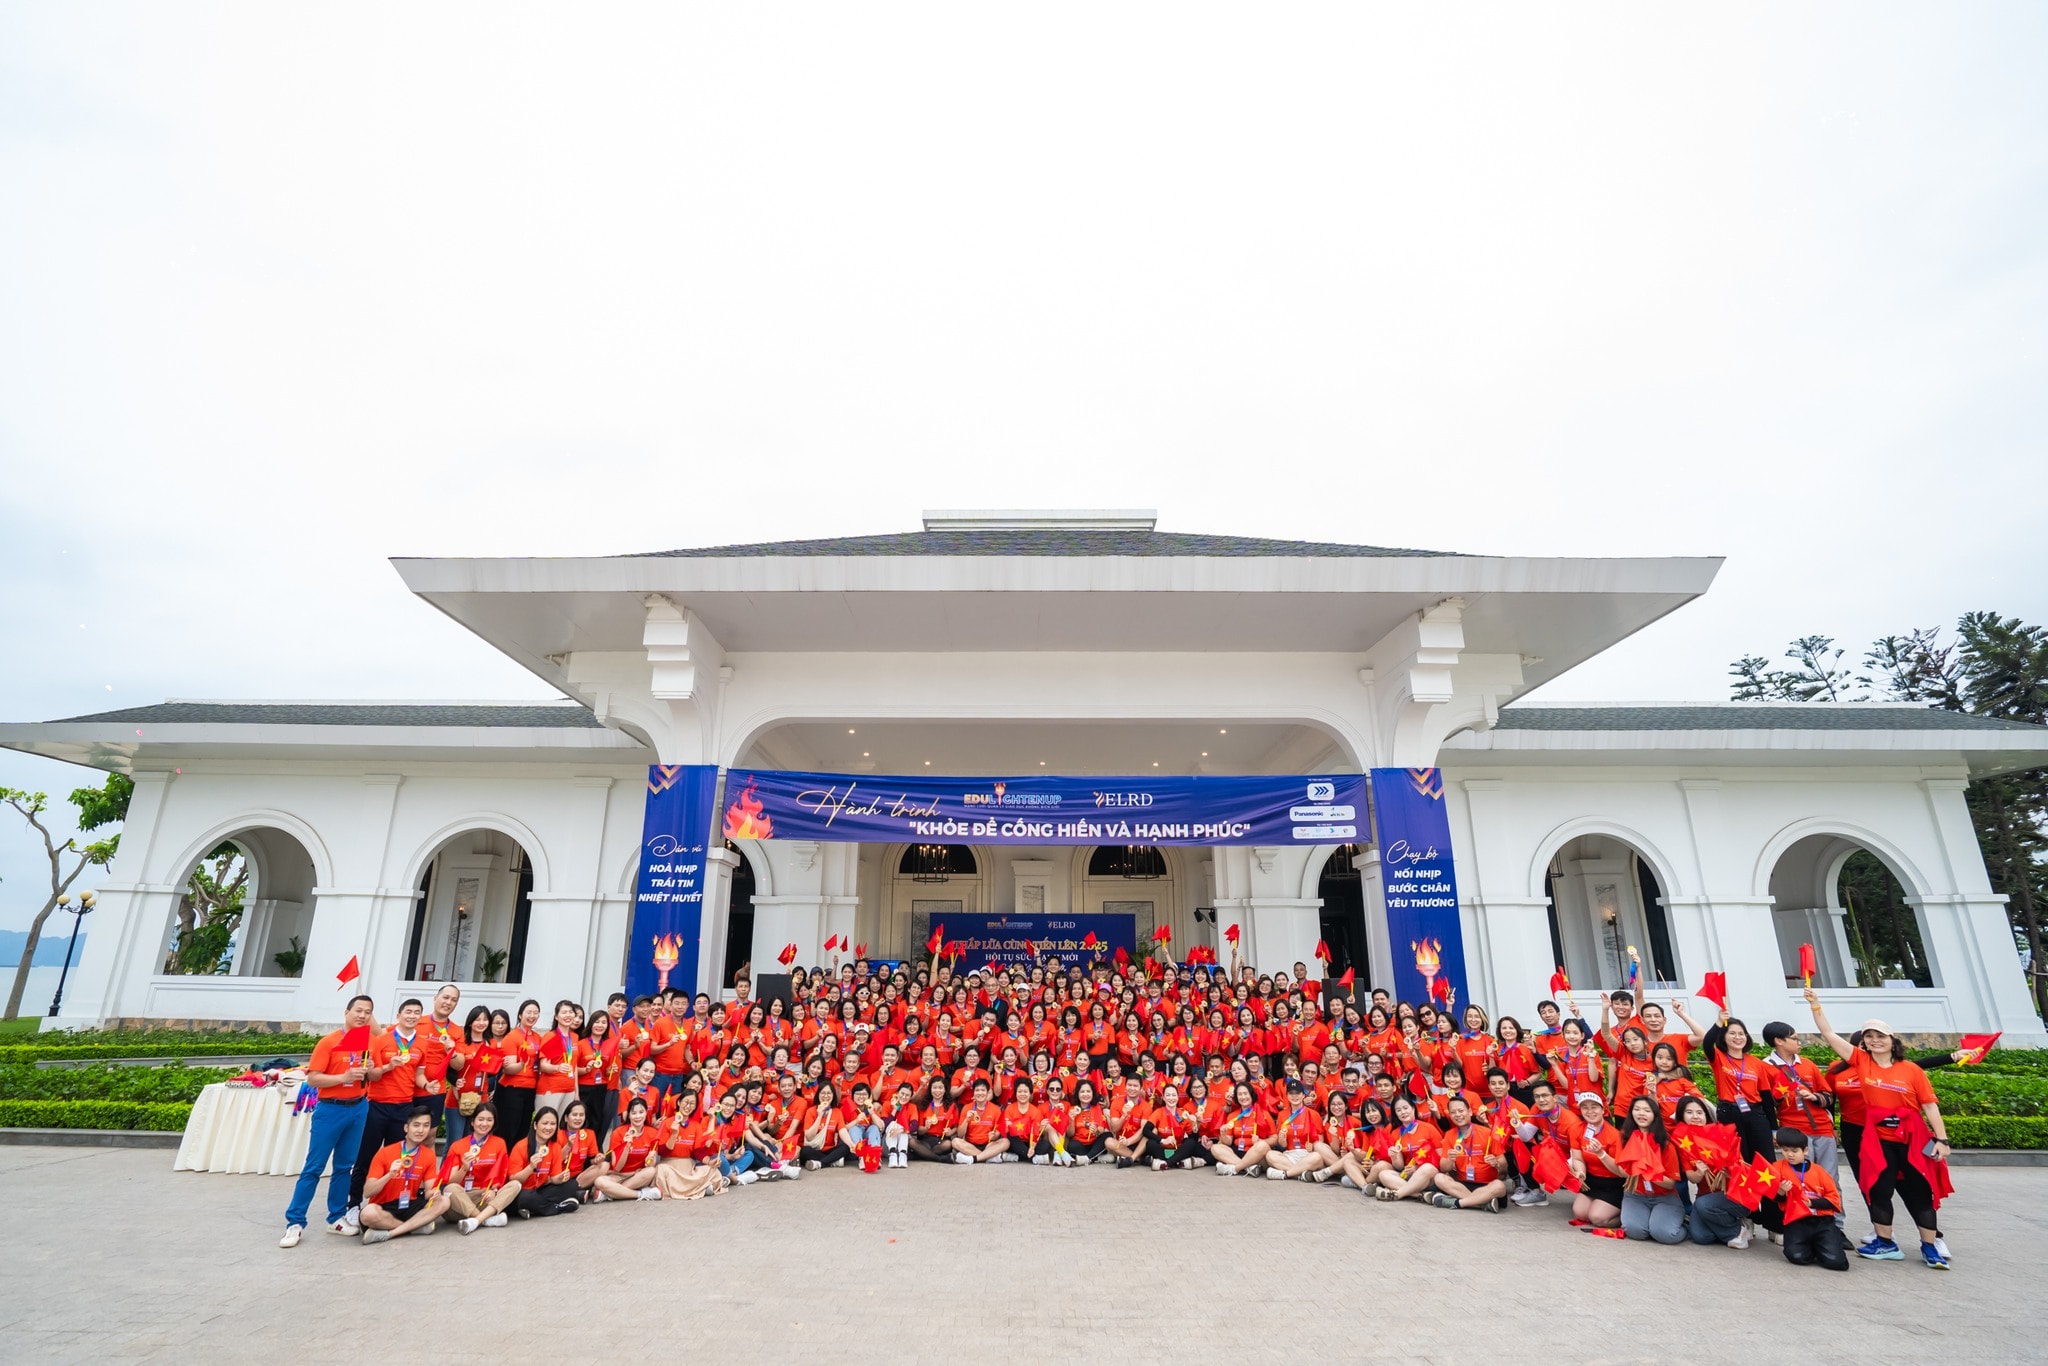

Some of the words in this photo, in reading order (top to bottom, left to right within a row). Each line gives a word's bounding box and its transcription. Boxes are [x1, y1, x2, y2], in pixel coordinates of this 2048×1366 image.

[796, 782, 882, 828] Hành
[884, 793, 942, 817] trình
[1105, 793, 1153, 806] ELRD
[972, 816, 998, 837] ĐỂ
[1001, 817, 1053, 837] CỐNG
[1057, 817, 1101, 837] HIẾN
[1105, 820, 1131, 838] VÀ
[1135, 822, 1188, 841] HẠNH
[649, 862, 672, 873] HOÀ
[1394, 867, 1414, 878] NỐI
[1415, 869, 1442, 880] NHỊP
[651, 877, 676, 888] TRÁI
[1388, 882, 1418, 893] BƯỚC
[1420, 881, 1451, 893] CHÂN
[638, 891, 670, 904] NHIỆT
[1387, 897, 1408, 908] YÊU
[1410, 897, 1455, 908] THƯƠNG
[1052, 921, 1076, 929] ELRD
[1058, 939, 1078, 950] LÊN
[1061, 952, 1079, 961] MỚI
